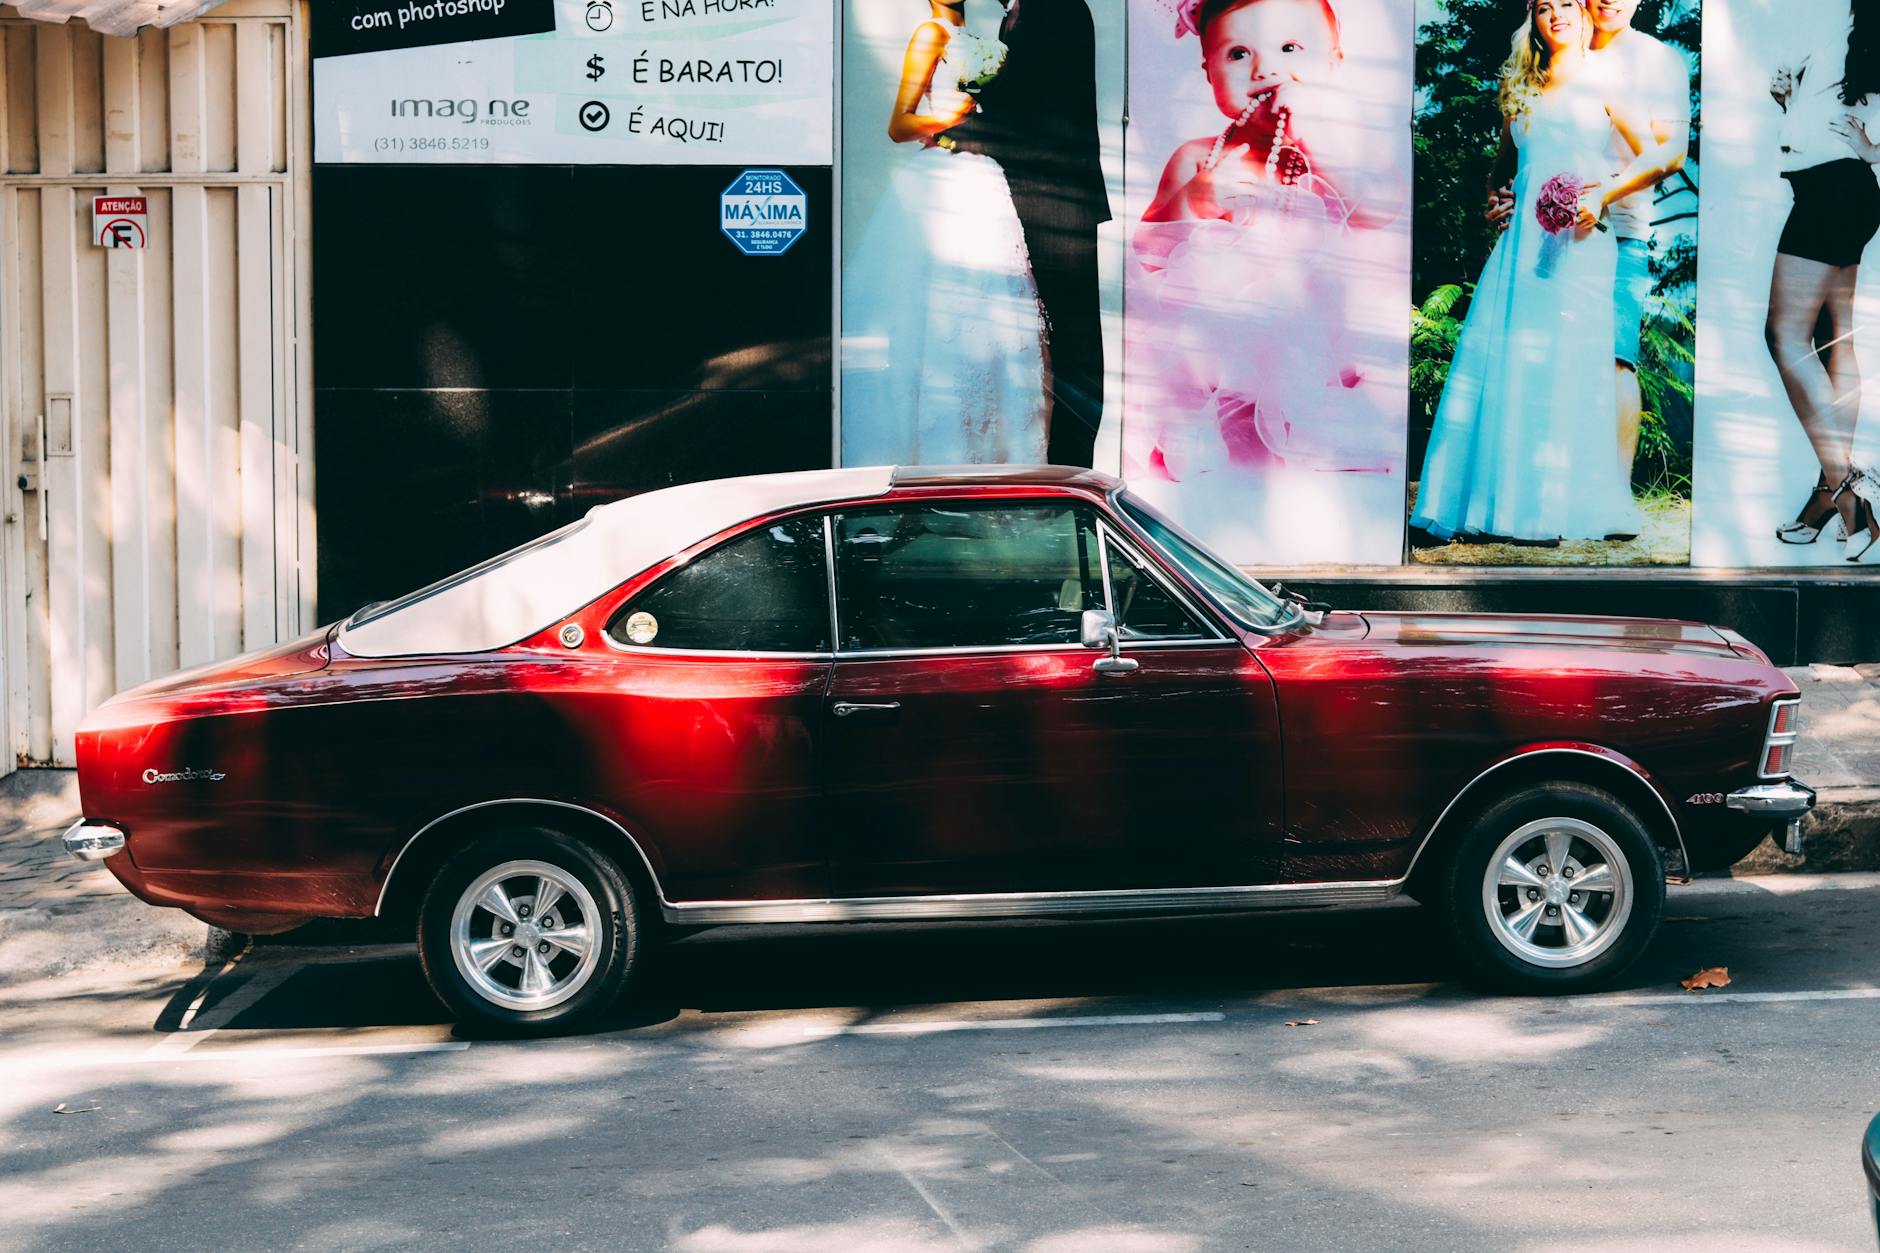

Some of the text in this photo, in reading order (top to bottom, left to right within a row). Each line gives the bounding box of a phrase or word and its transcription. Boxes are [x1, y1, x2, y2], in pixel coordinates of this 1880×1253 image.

[351, 0, 505, 30] com photoshop
[662, 0, 696, 19] NA
[633, 50, 649, 83] É
[660, 59, 782, 83] BARATO!
[391, 99, 530, 124] imagne
[628, 105, 724, 143] É AQUI!
[374, 137, 489, 152] (31) 3846.5219
[745, 182, 782, 194] 24HS
[101, 200, 142, 213] ATENÇÃO
[725, 200, 802, 220] MÁXIMA
